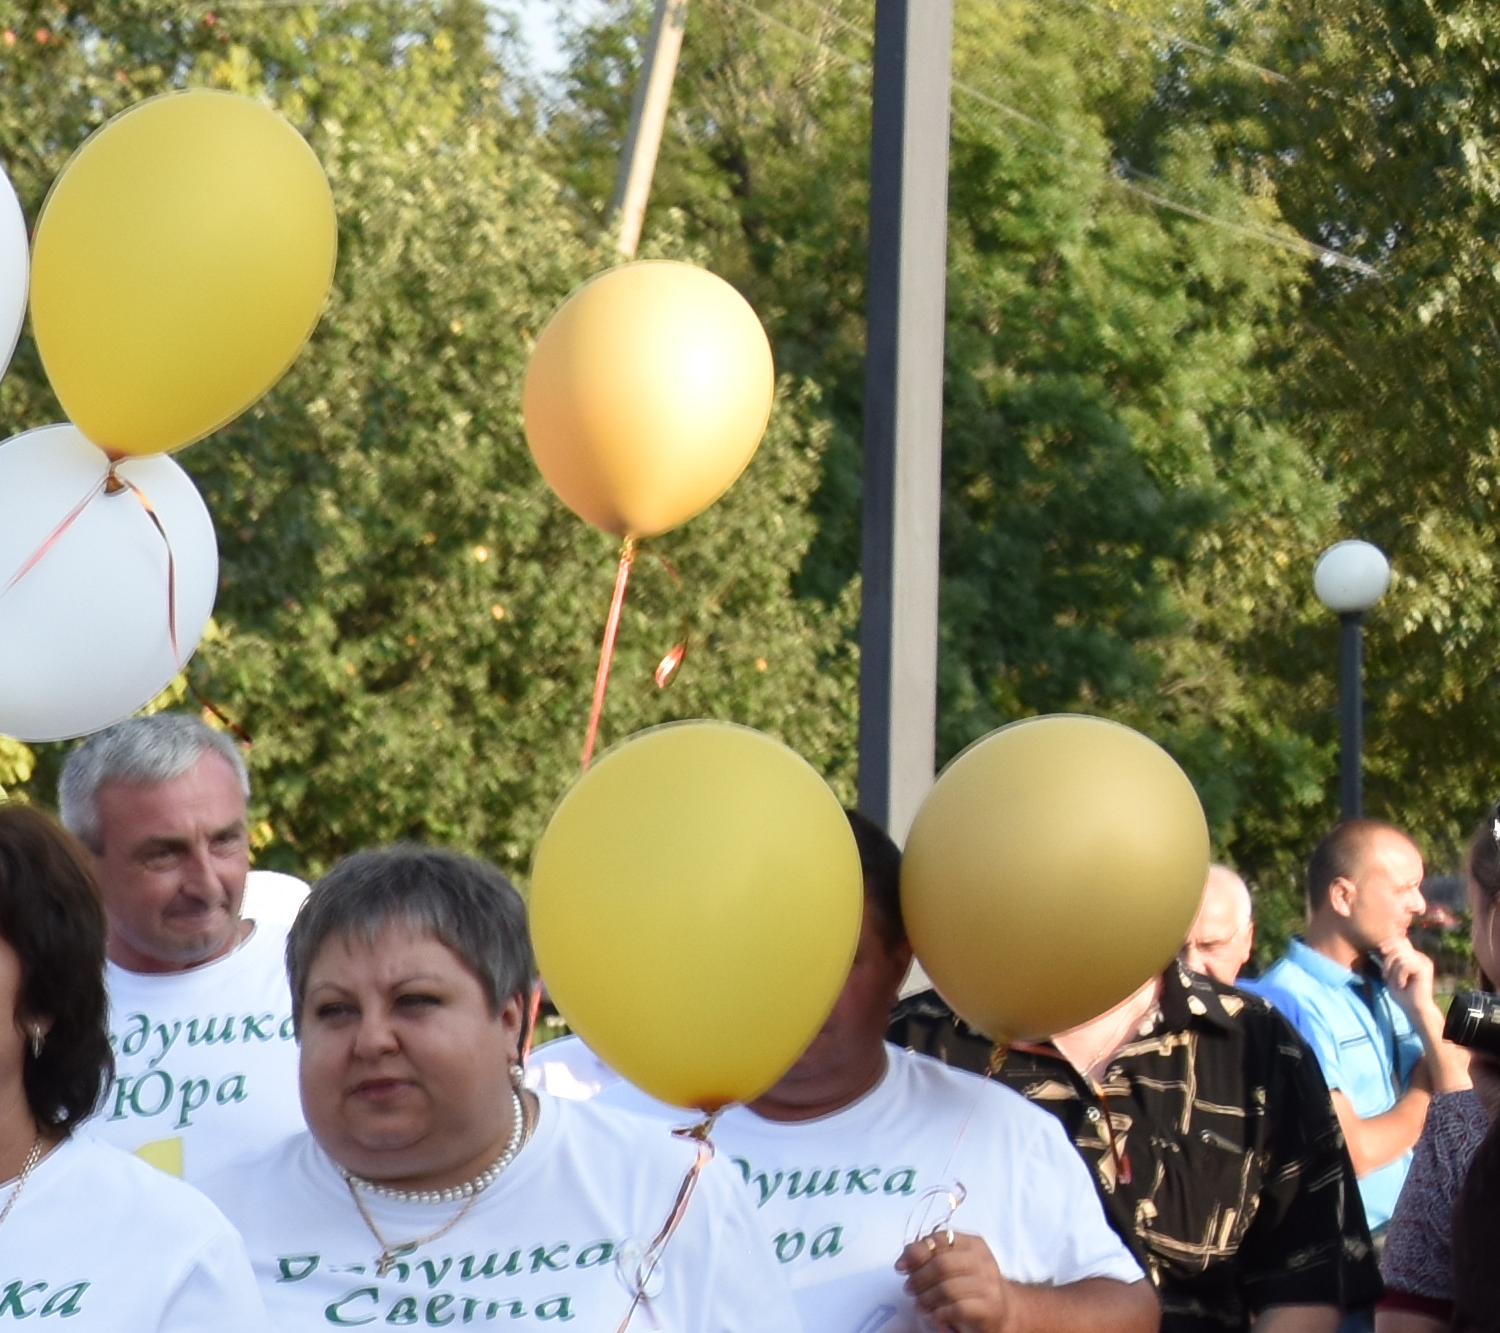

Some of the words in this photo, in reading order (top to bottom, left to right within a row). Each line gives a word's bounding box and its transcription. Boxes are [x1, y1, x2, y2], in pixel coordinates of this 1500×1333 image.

[104, 1010, 297, 1068] душка
[107, 1068, 248, 1130] Юра
[324, 1285, 576, 1328] Света
